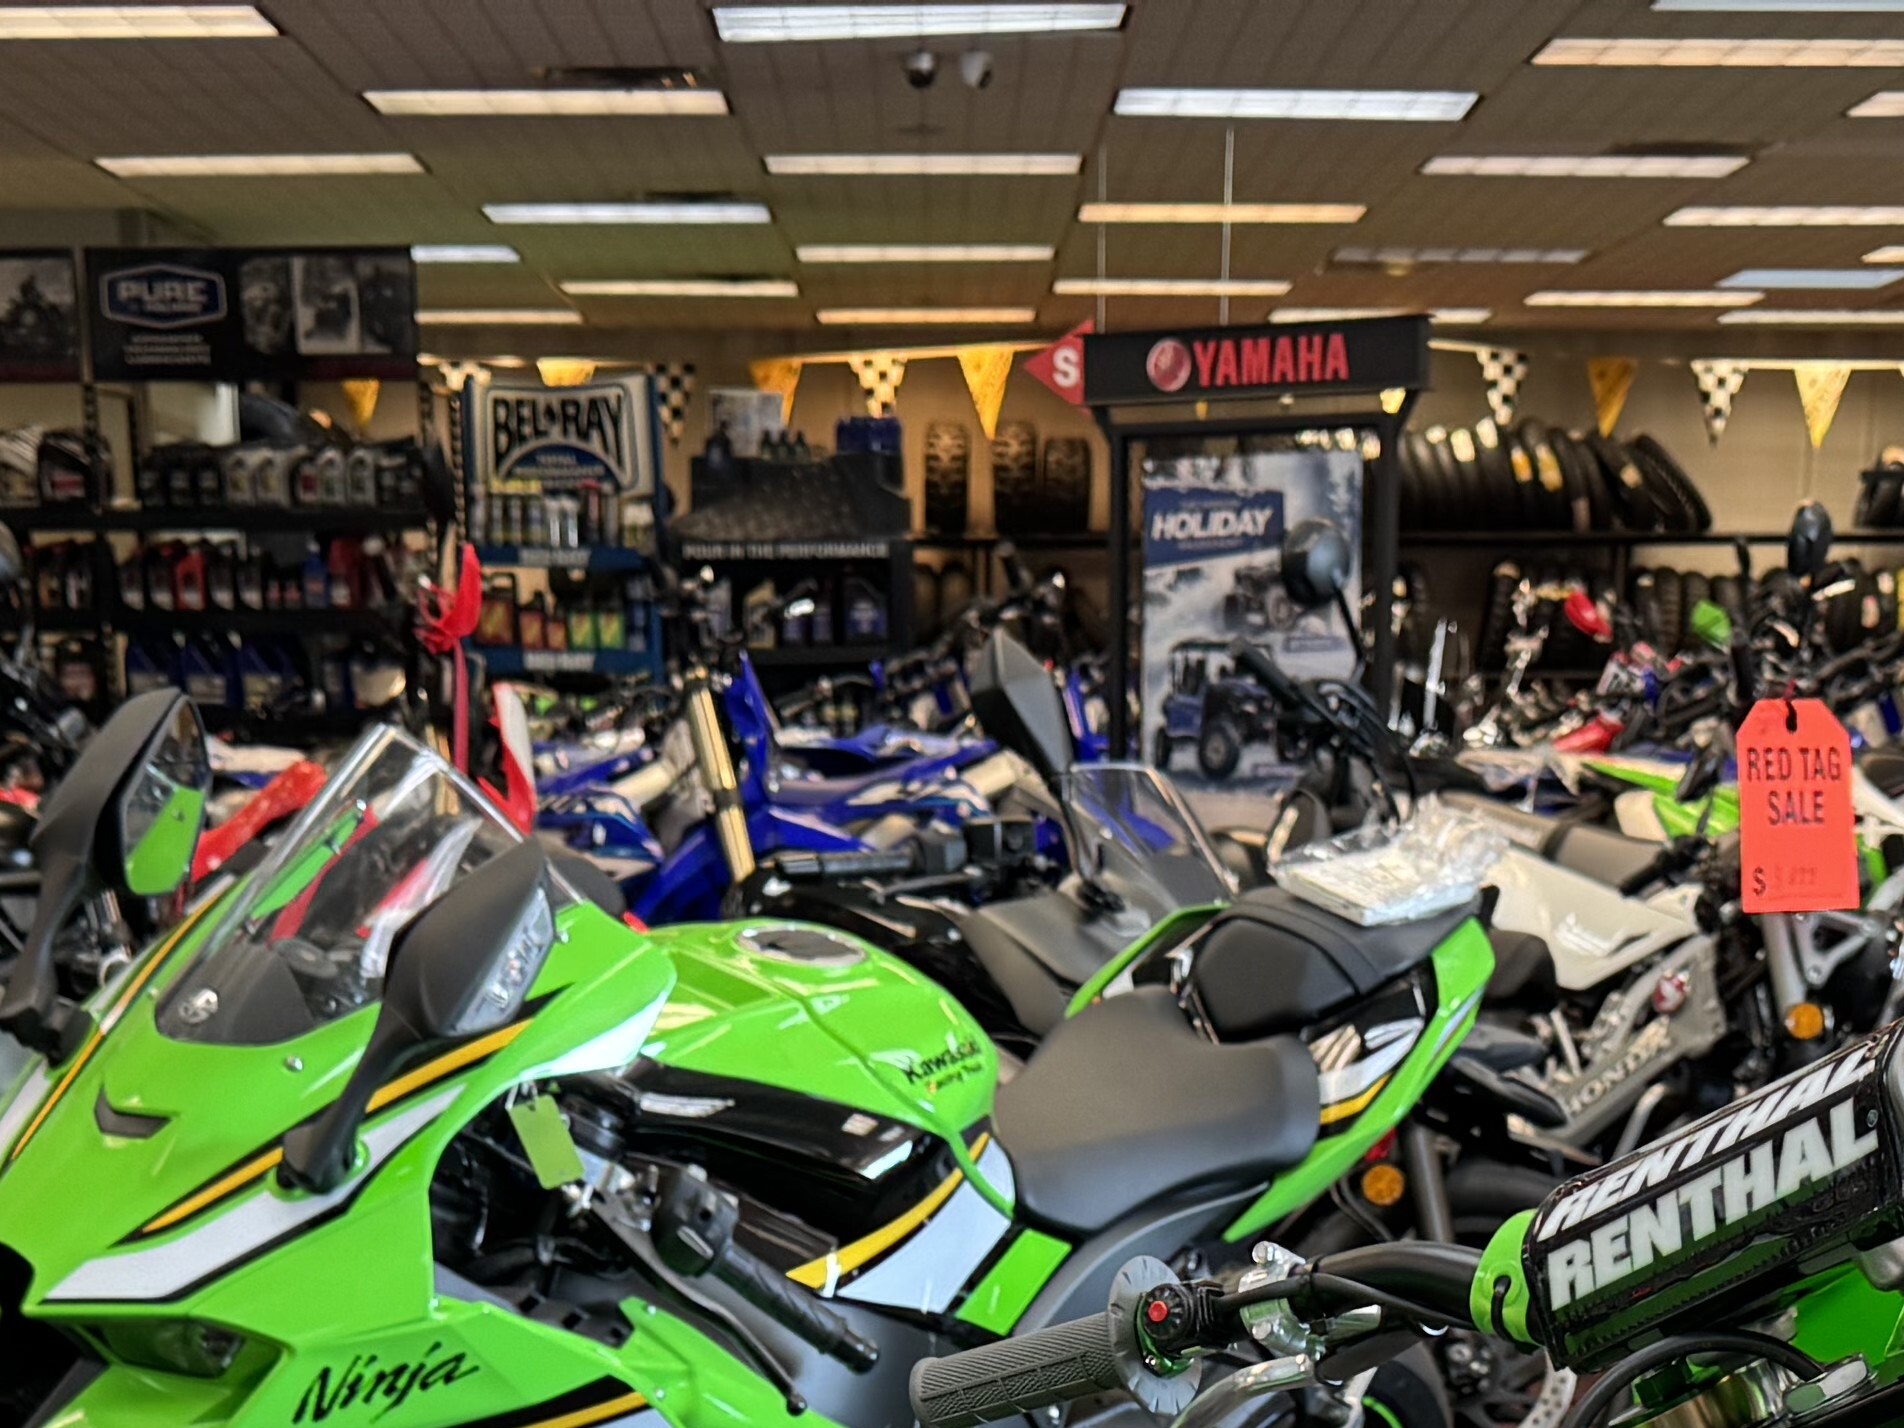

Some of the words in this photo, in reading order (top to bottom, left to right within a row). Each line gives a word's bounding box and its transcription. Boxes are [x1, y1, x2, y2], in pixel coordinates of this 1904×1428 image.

[116, 280, 209, 302] PURE
[1193, 333, 1349, 387] YAMAHA
[1151, 507, 1274, 541] HOLIDAY
[1747, 747, 1791, 783] RED
[1798, 747, 1841, 783] TAG
[1768, 790, 1825, 826] SALE
[1568, 1016, 1672, 1114] HONDA
[1536, 1040, 1877, 1242] RENTHAL
[1547, 1098, 1880, 1311] RENTHAL
[291, 1341, 480, 1427] Ninja
